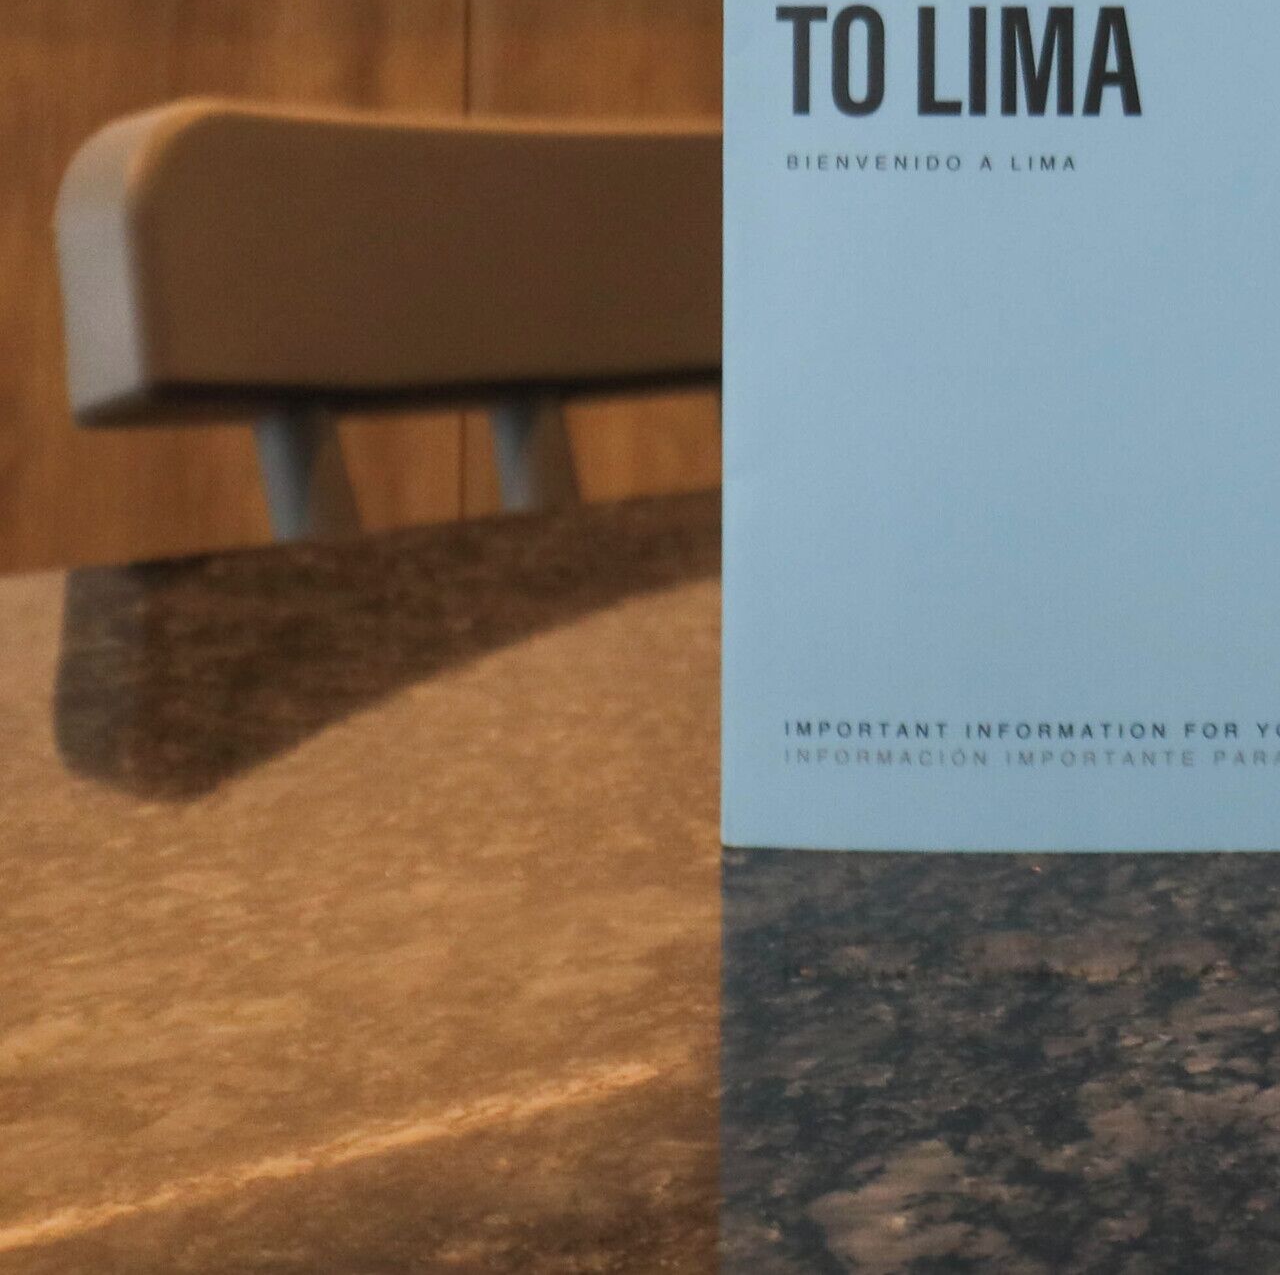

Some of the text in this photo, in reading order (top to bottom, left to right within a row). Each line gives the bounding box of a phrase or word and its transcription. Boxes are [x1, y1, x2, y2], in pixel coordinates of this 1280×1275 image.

[776, 4, 1142, 117] TO LIMA
[786, 155, 1076, 172] BIENVENIDO A LIMA
[784, 721, 949, 739] IMPORTANT
[966, 721, 1167, 739] INFORMATION
[1184, 721, 1239, 739] FOR
[784, 746, 988, 766] INFORMACIÓN
[1006, 748, 1195, 766] IMPORTANTE
